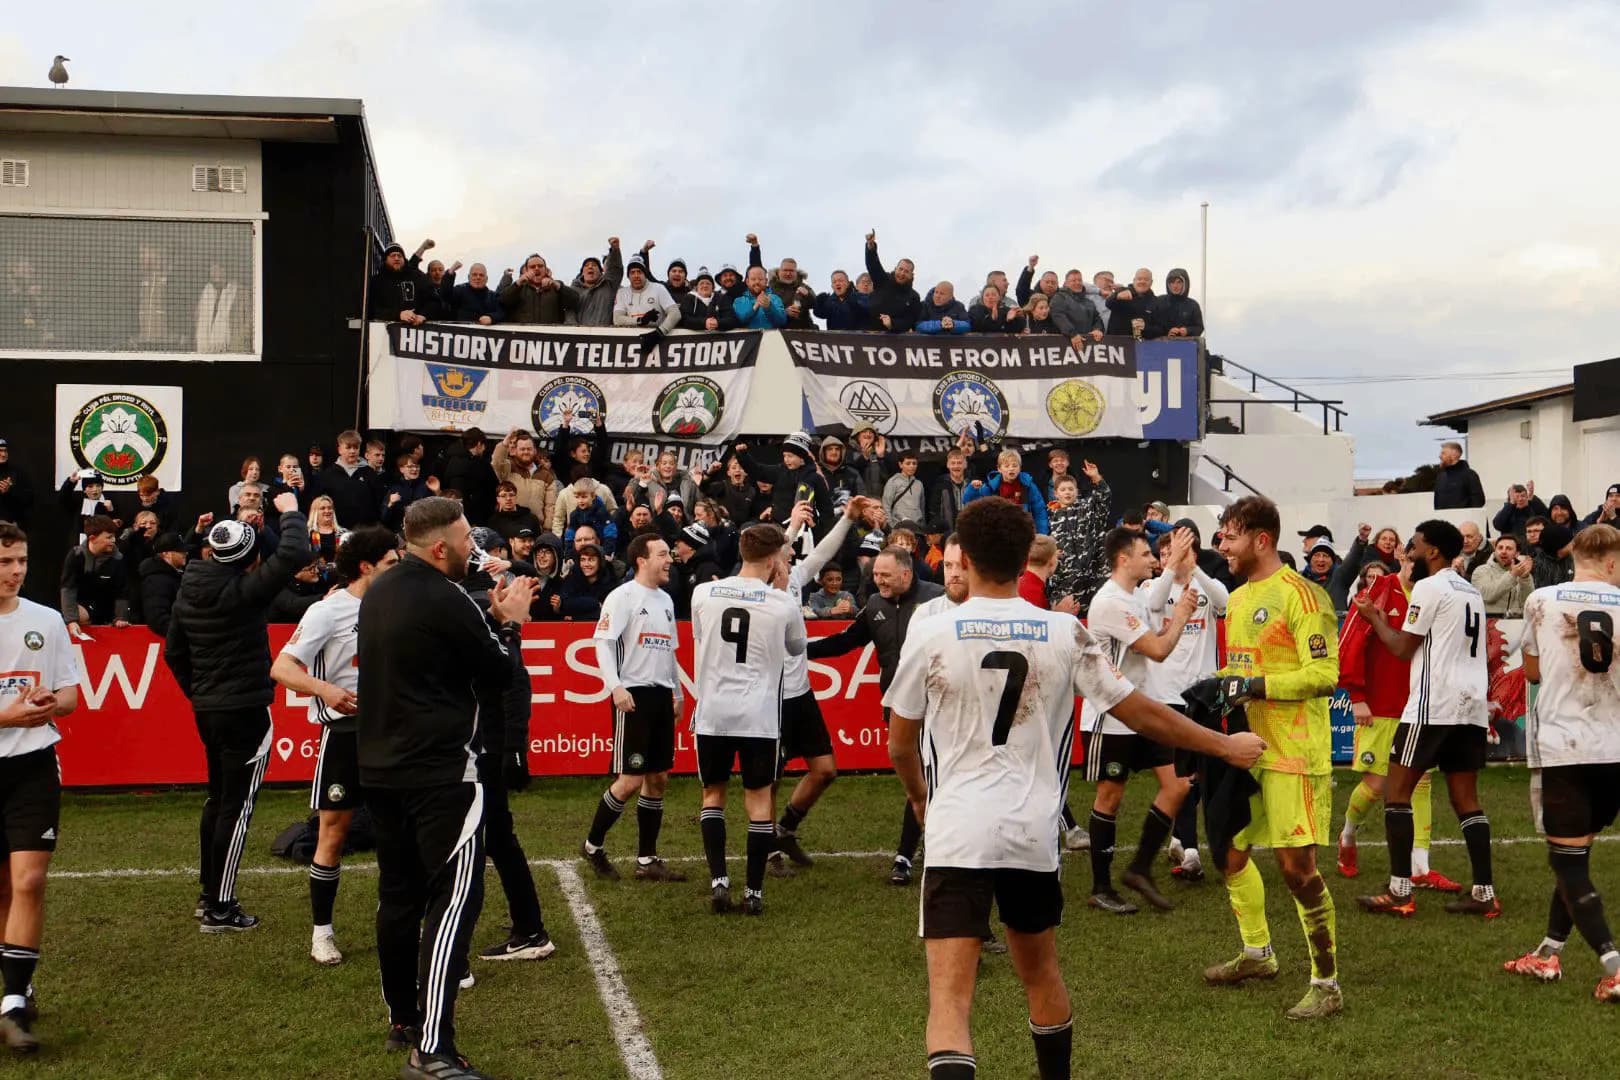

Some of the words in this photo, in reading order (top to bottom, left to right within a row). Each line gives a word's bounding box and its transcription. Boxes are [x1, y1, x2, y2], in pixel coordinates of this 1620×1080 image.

[400, 327, 505, 362] HISTORY
[509, 339, 571, 366] ONLY
[575, 342, 641, 368] TELLS
[644, 343, 662, 368] A
[667, 339, 746, 368] STORY
[790, 339, 855, 365] SENT
[862, 346, 898, 366] TO
[905, 347, 943, 367] ME
[950, 347, 1022, 368] FROM
[1028, 344, 1126, 367] HEAVEN
[721, 607, 750, 663] 9
[960, 621, 1010, 635] JEWSON
[1013, 622, 1046, 638] Rhyl
[1465, 602, 1480, 657] 4
[981, 651, 1028, 746] 7
[530, 733, 615, 758] enbighs
